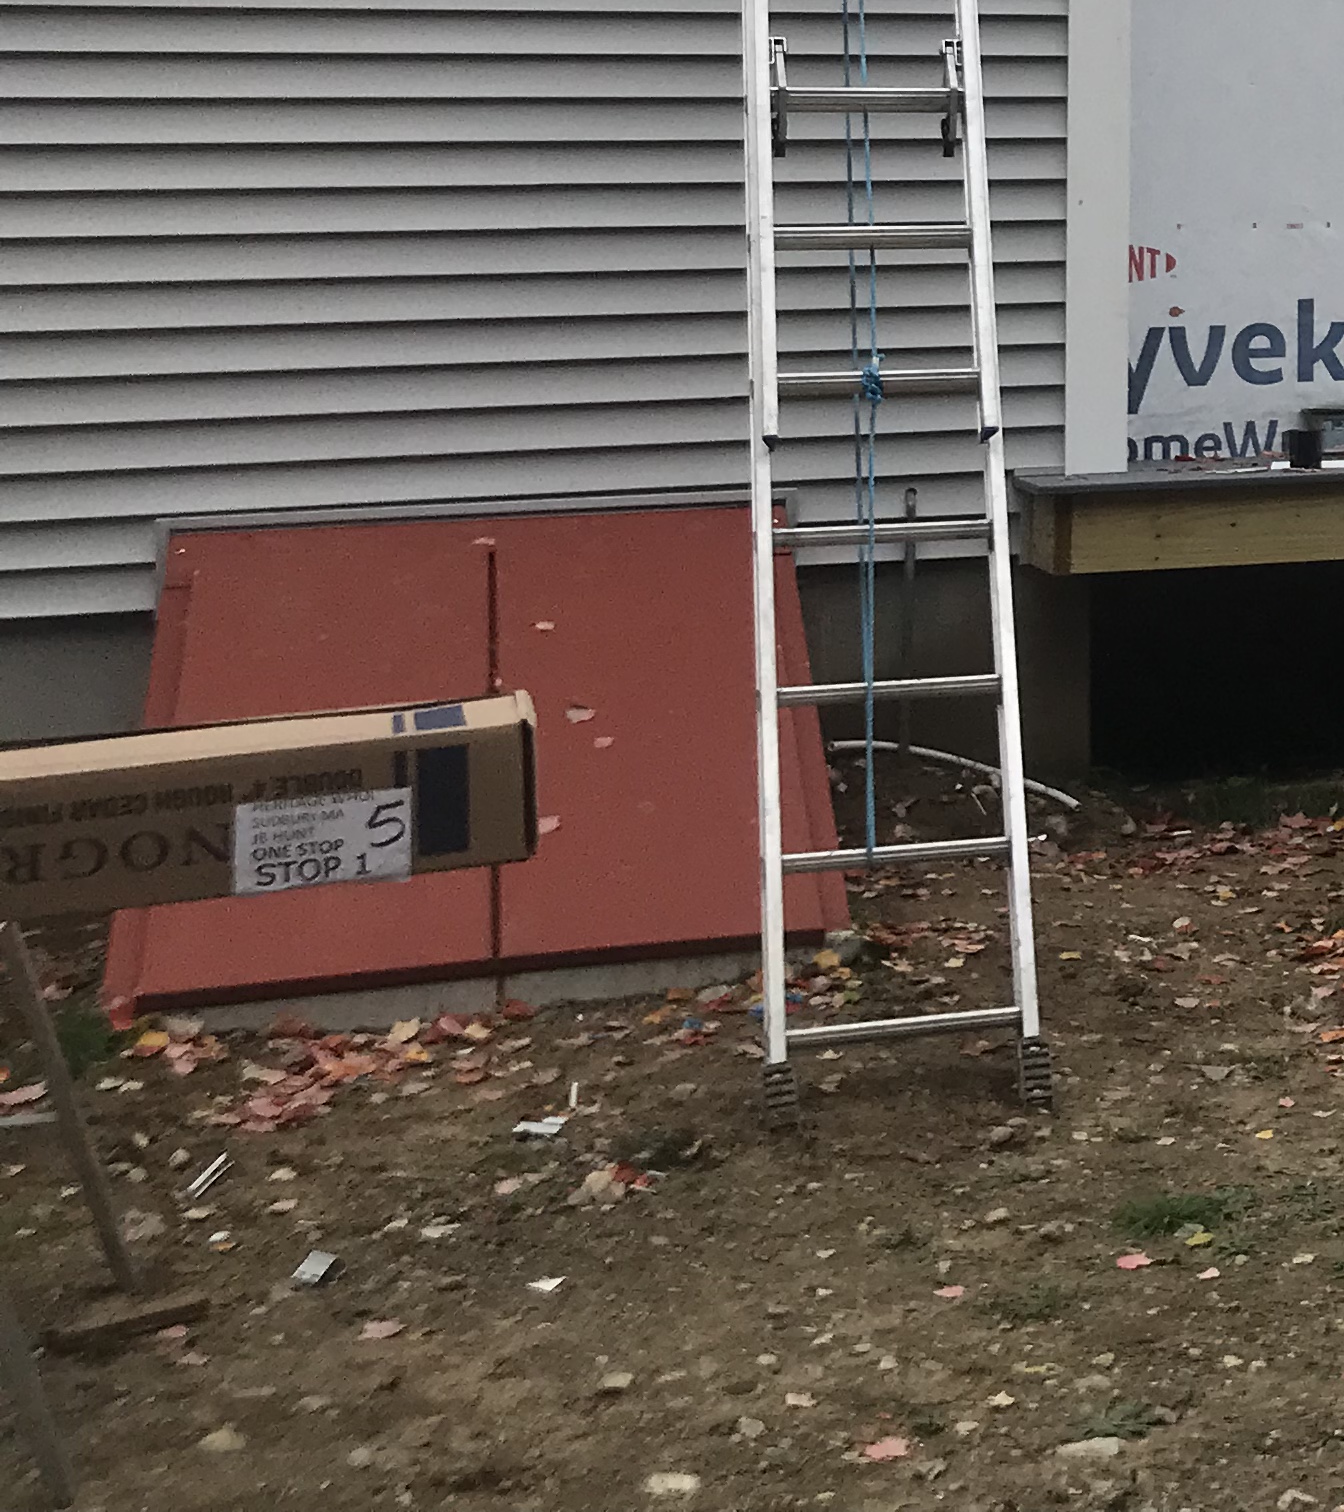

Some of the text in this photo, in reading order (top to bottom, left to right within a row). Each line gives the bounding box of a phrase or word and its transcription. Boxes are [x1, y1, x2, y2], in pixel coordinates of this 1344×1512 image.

[252, 812, 316, 829] SUDBURY
[366, 799, 406, 847] 5
[252, 839, 345, 862] ONE STOP
[255, 852, 372, 887] STOP 1
